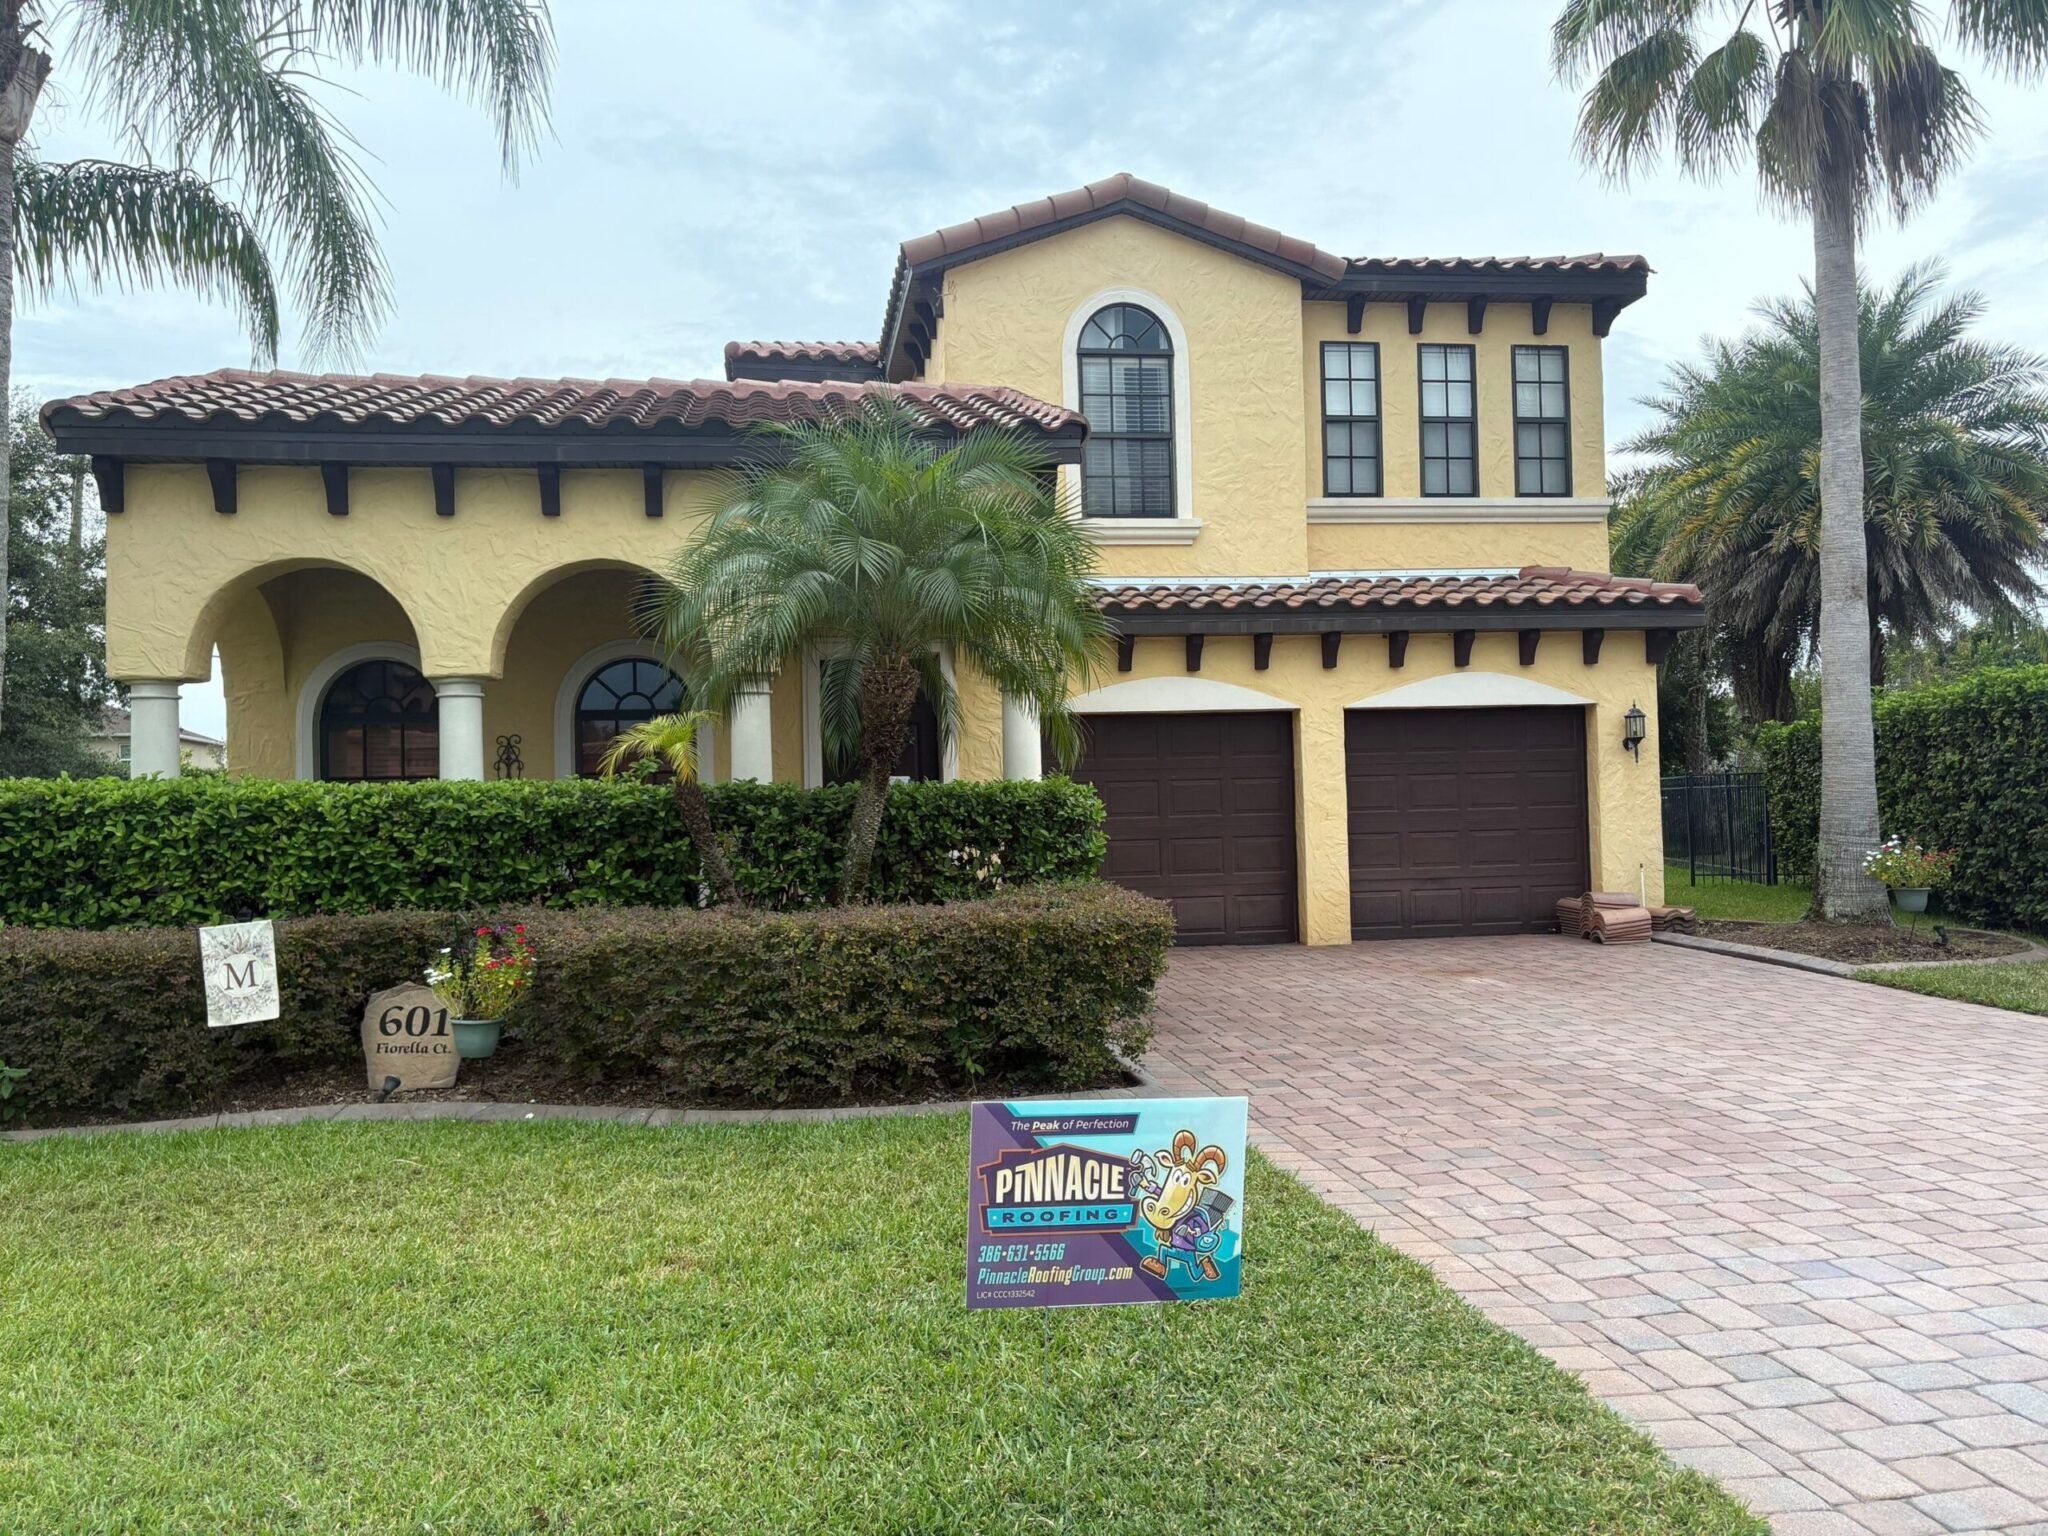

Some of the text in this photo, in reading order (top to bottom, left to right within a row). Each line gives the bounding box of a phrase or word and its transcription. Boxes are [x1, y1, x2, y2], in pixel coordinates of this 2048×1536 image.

[223, 960, 260, 990] M
[379, 1005, 449, 1036] 601
[376, 1042, 452, 1054] Fiorella Ct.
[1011, 1119, 1129, 1132] The Peak of Perfection
[1002, 1209, 1118, 1223] ROOFING
[976, 1264, 1134, 1286] PinnacleRoofingGroup.com
